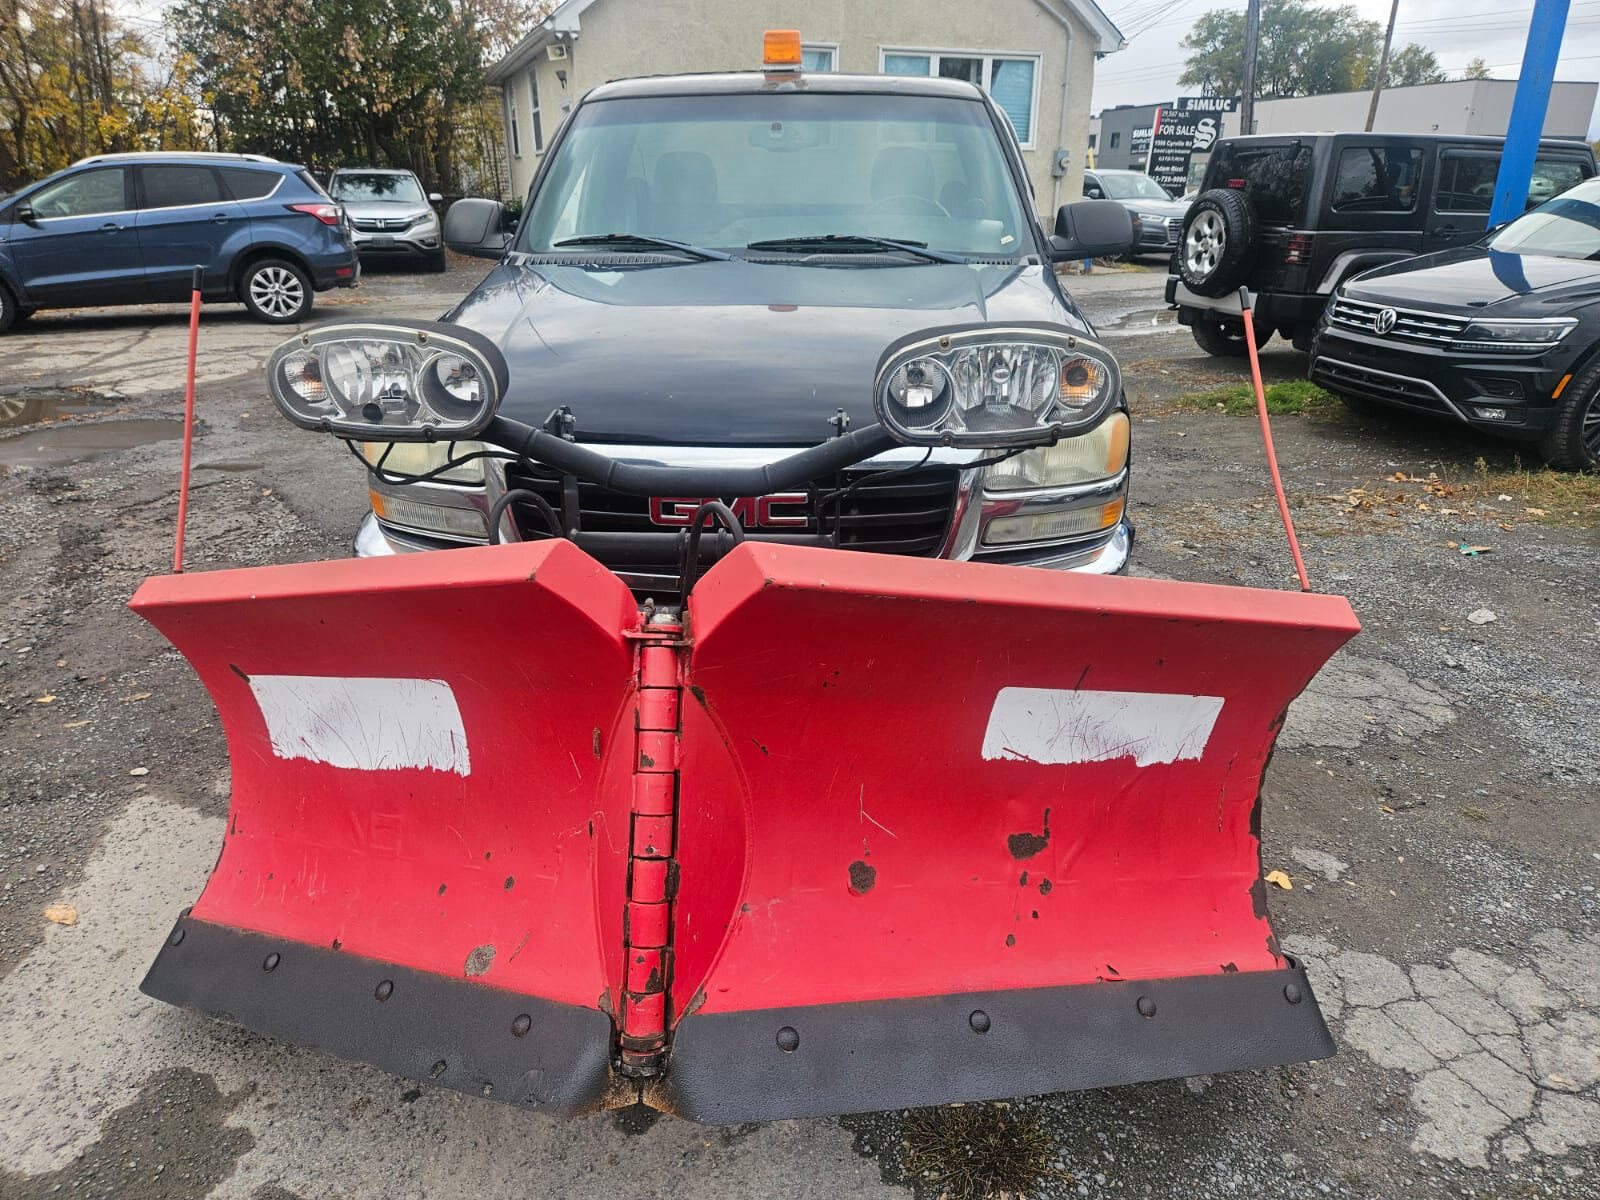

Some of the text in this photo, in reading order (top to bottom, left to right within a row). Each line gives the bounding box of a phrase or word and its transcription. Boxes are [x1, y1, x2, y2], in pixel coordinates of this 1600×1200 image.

[1186, 98, 1231, 111] SIMLUC
[1158, 125, 1196, 136] FOR SALE
[648, 492, 808, 528] GMC
